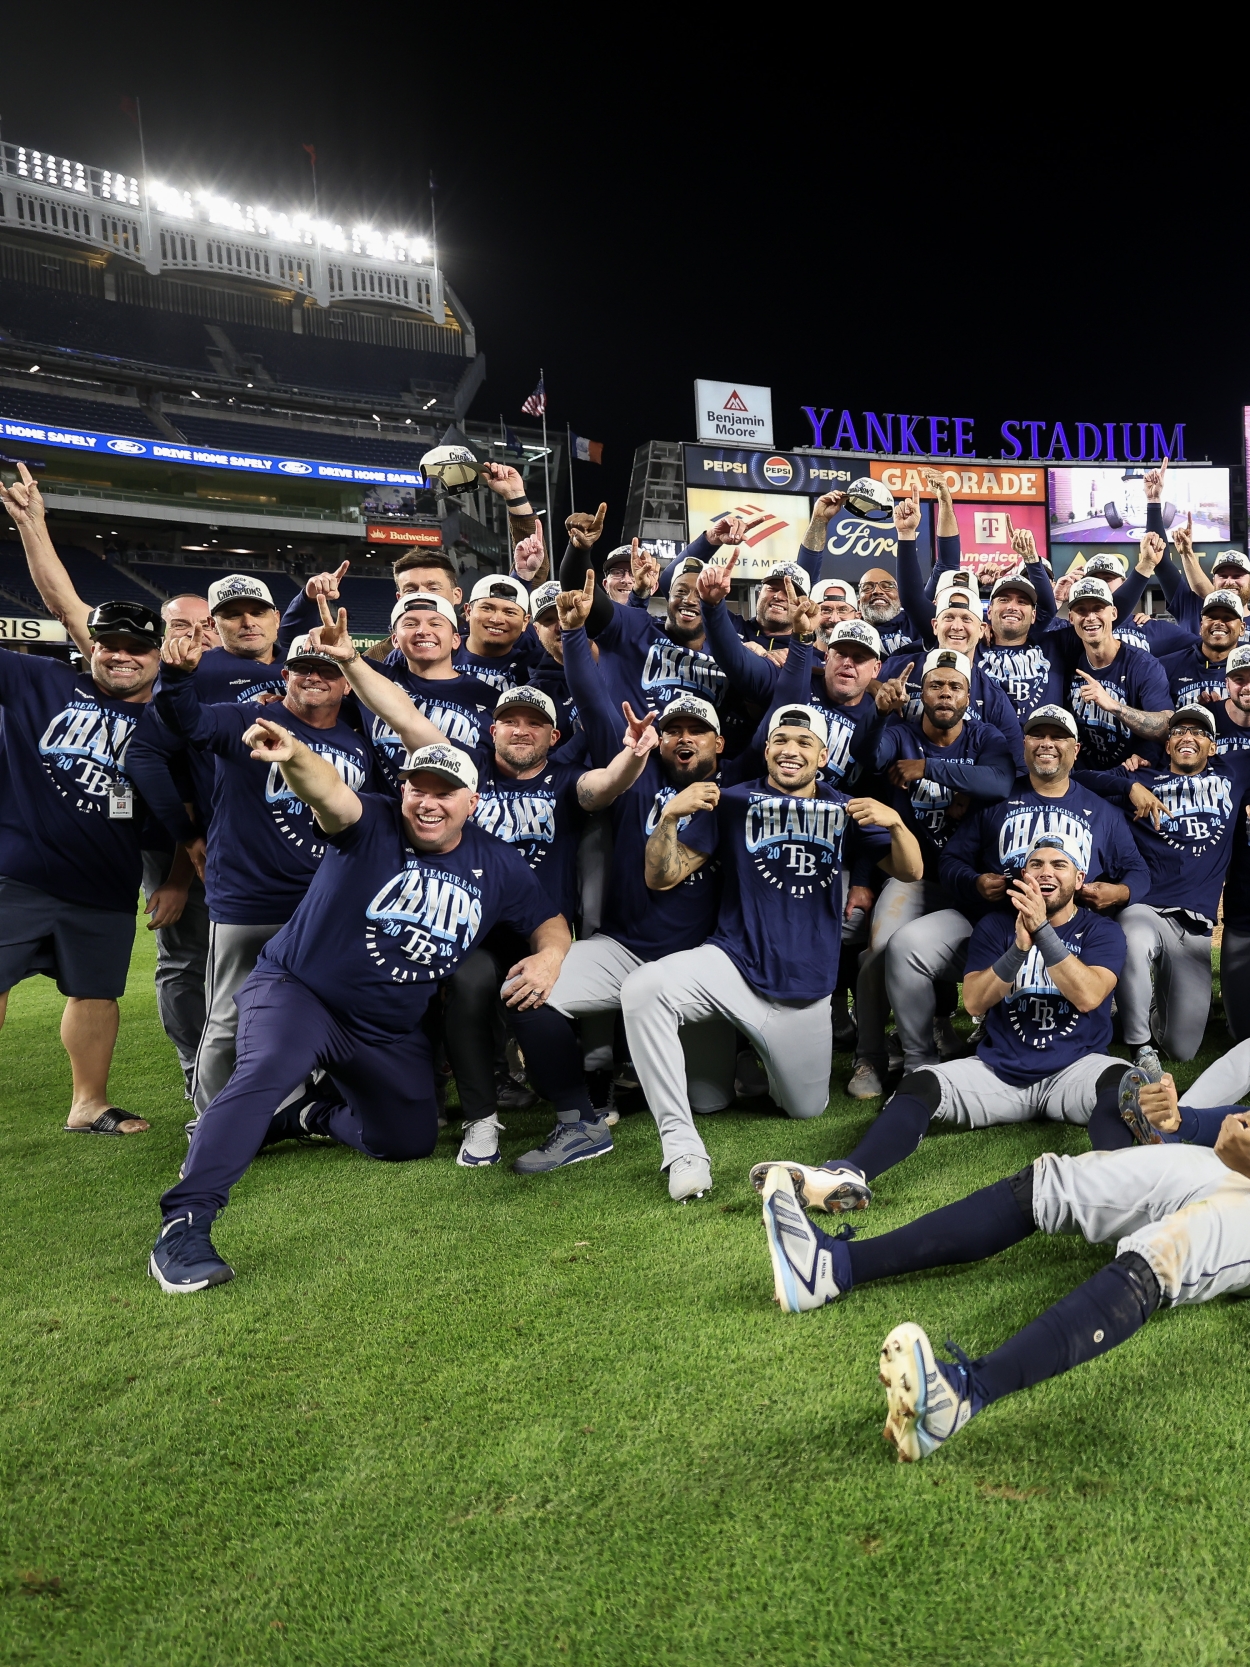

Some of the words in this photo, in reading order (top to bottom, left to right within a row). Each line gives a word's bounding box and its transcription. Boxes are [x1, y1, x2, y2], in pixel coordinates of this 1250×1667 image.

[707, 411, 765, 429] Benjamin
[6, 425, 46, 440] HOME
[48, 431, 97, 447] SAFELY
[715, 424, 756, 438] Moore
[801, 405, 977, 457] YANKEE
[1001, 421, 1188, 461] STADIUM
[153, 446, 192, 460] DRIVE
[193, 452, 229, 465] HOME
[229, 457, 273, 469] SAFELY
[703, 459, 747, 474] PEPSI
[319, 466, 353, 479] DRIVE
[354, 470, 386, 482] HOME
[387, 474, 424, 485] SAFELY
[765, 467, 791, 476] PEPSI
[809, 469, 851, 482] PEPSI
[390, 531, 440, 543] Budweiser
[982, 518, 999, 538] T
[828, 519, 900, 557] For
[734, 559, 748, 567] OF
[217, 587, 263, 601] CHAMPIONS
[1073, 588, 1105, 598] CHAMPIONS
[838, 630, 873, 645] CHAMPIONS
[236, 681, 276, 703] AMERICAN
[659, 688, 672, 702] 20
[1178, 681, 1208, 696] AMERICAN
[504, 693, 547, 710] CHAMPIONS
[429, 699, 463, 716] LEAGUE
[462, 706, 482, 729] EAST
[828, 712, 858, 731] LEAGUE
[1107, 733, 1117, 743] 26
[383, 745, 396, 759] 20
[56, 755, 74, 771] 20
[414, 755, 461, 773] CHAMPIONS
[287, 800, 303, 815] 20
[1004, 805, 1044, 820] AMERICAN
[1045, 805, 1075, 818] LEAGUE
[1074, 815, 1092, 830] EAST
[272, 809, 304, 846] TAMPA
[1168, 821, 1179, 832] 20
[1179, 816, 1211, 840] TB
[1210, 816, 1221, 827] 26
[999, 811, 1093, 876] CHAMPS
[1159, 831, 1186, 851] TAMPA
[766, 846, 781, 860] 20
[782, 843, 818, 877] TB
[820, 851, 833, 865] 26
[1014, 857, 1026, 868] 20
[424, 868, 462, 888] LEAGUE
[461, 879, 482, 899] EAST
[754, 857, 784, 890] TAMPA
[790, 884, 813, 895] BAY
[365, 868, 483, 951] CHAMPS
[383, 921, 402, 938] 20
[400, 926, 438, 966] TB
[440, 943, 453, 957] 26
[365, 926, 386, 967] TAMPA
[391, 966, 418, 982] BAY
[1018, 1001, 1028, 1013] 20
[1030, 996, 1058, 1032] TB
[1058, 1001, 1070, 1014] 26
[1033, 1033, 1053, 1047] BAY
